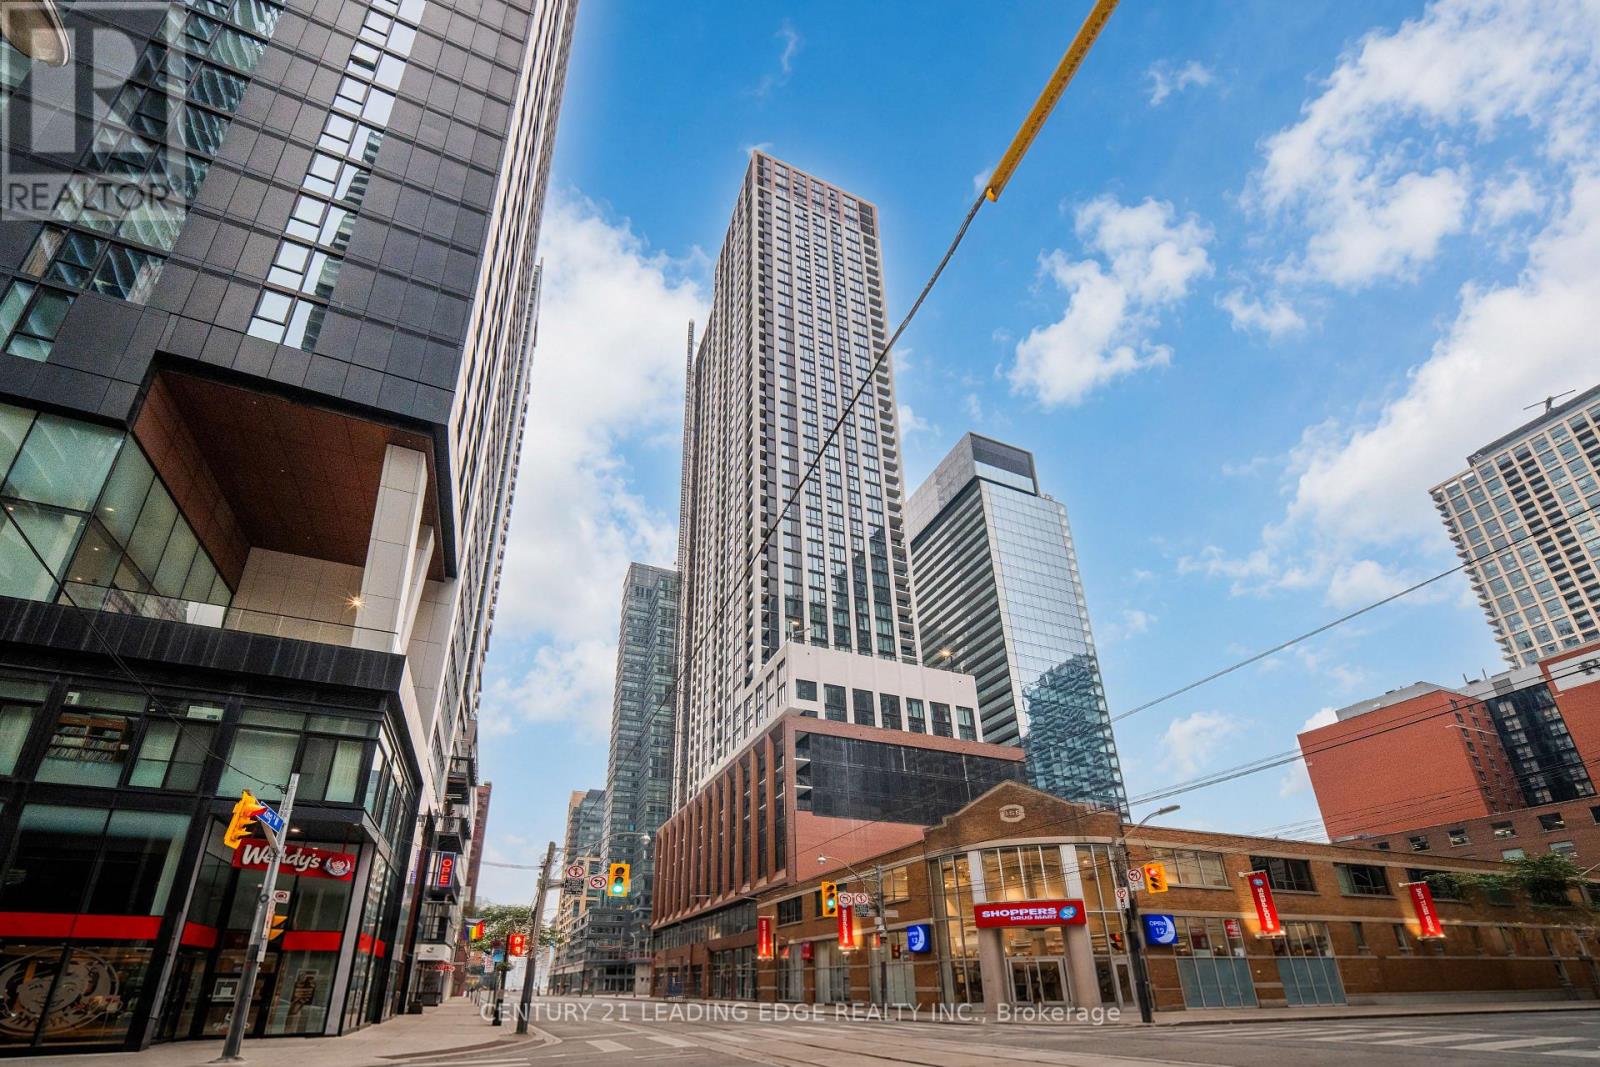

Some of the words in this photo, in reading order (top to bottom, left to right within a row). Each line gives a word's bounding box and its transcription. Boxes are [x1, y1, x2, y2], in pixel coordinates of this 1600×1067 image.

[982, 907, 1057, 918] SHOPPERS
[1034, 913, 1057, 921] MART
[1155, 927, 1165, 935] 12
